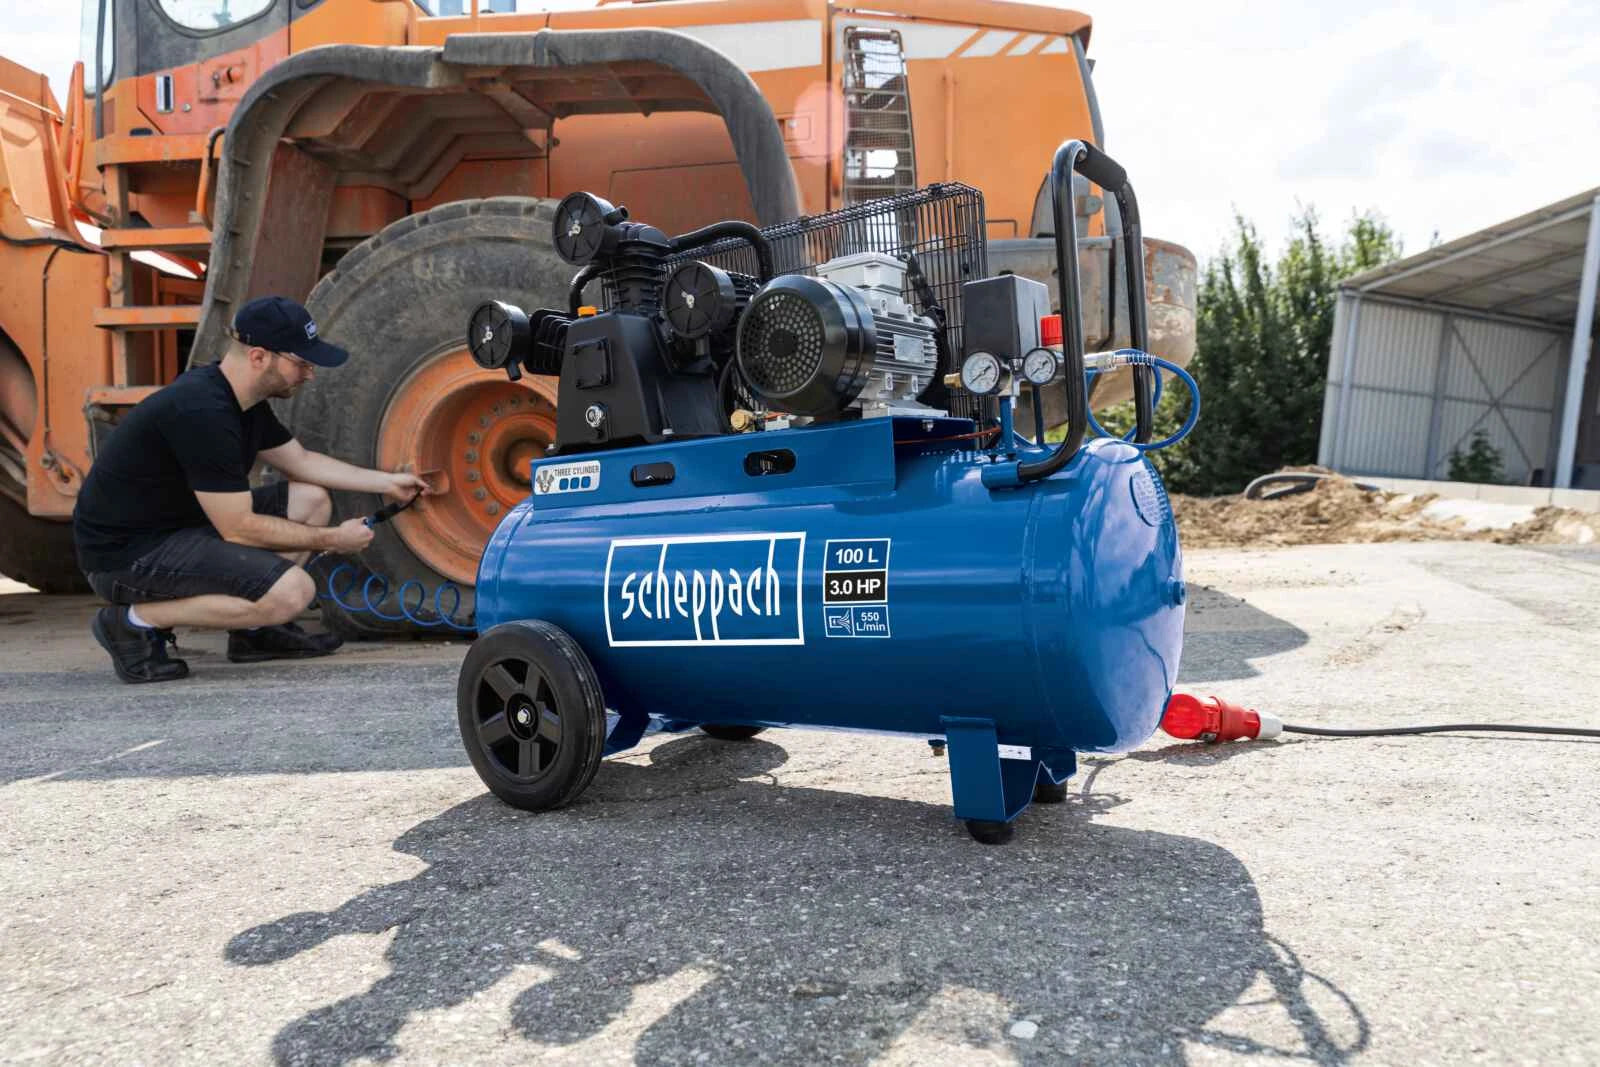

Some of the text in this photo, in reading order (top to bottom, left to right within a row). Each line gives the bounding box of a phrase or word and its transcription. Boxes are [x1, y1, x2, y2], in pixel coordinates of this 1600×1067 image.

[554, 464, 600, 477] THREE CYLINDER
[835, 547, 879, 564] 100 L
[621, 538, 781, 641] scheppach
[829, 578, 881, 595] 3.0 HP
[861, 611, 880, 622] 550
[856, 622, 886, 632] L/min
